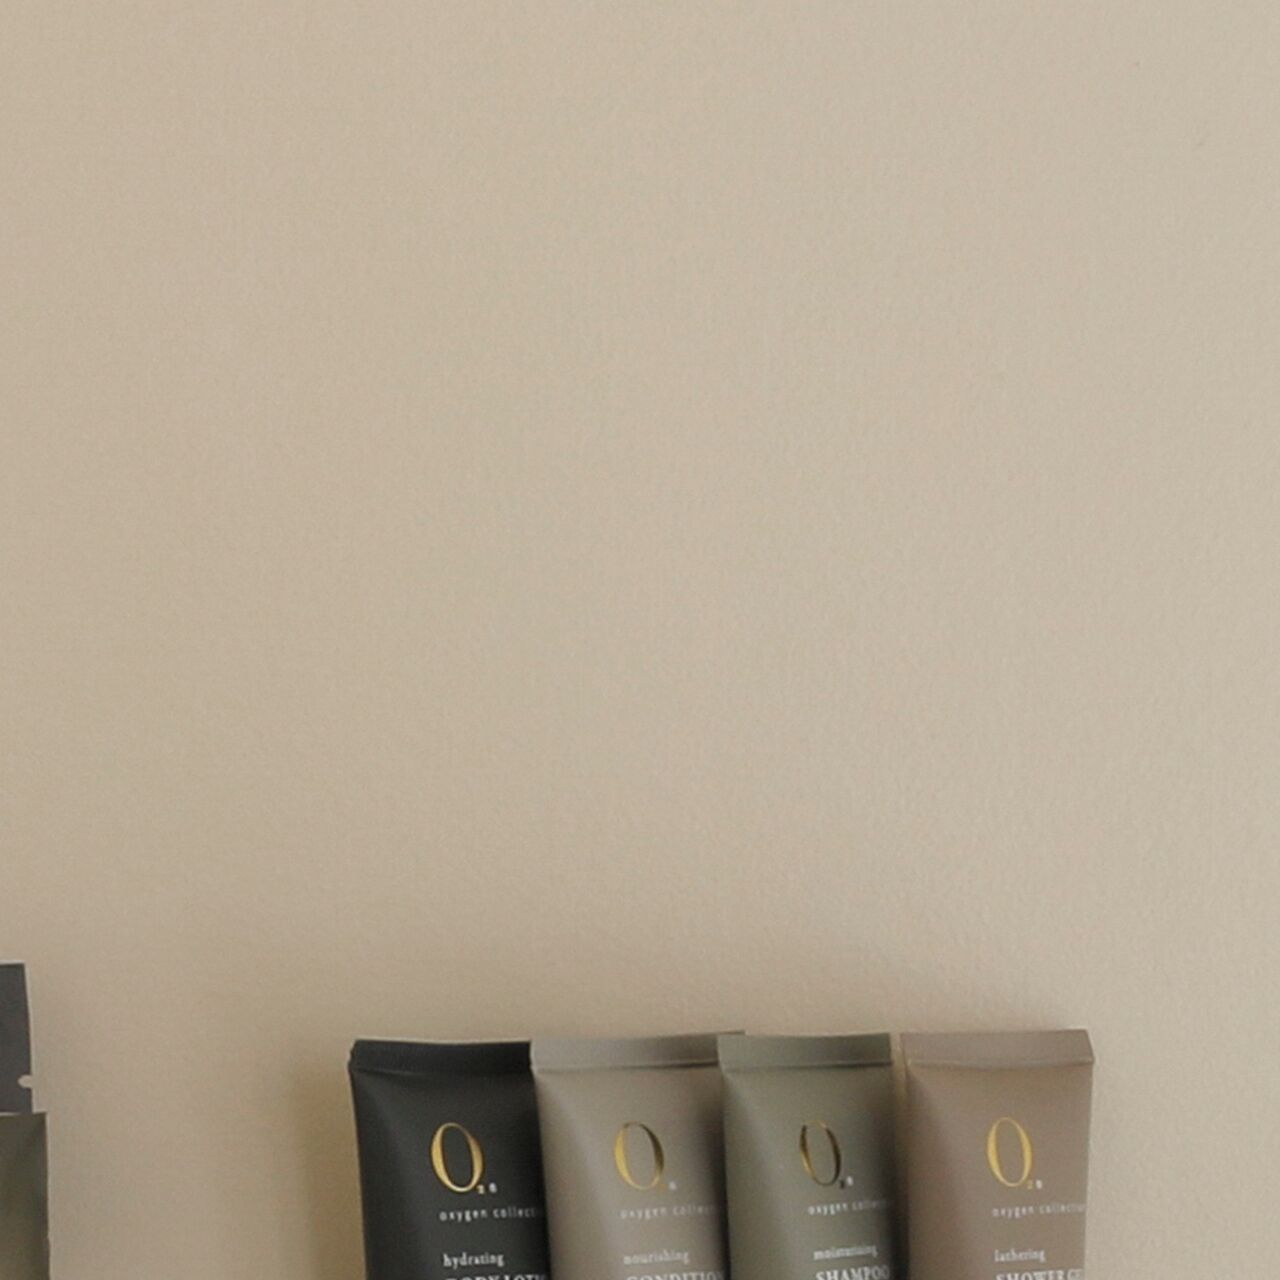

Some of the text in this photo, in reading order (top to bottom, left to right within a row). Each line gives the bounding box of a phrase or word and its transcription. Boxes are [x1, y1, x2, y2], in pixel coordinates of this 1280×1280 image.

[439, 1205, 538, 1223] oxygen collect
[991, 1204, 1035, 1220] oxygen
[443, 1251, 506, 1270] hydrating
[623, 1249, 690, 1265] nourishing
[994, 1247, 1047, 1264] lathering
